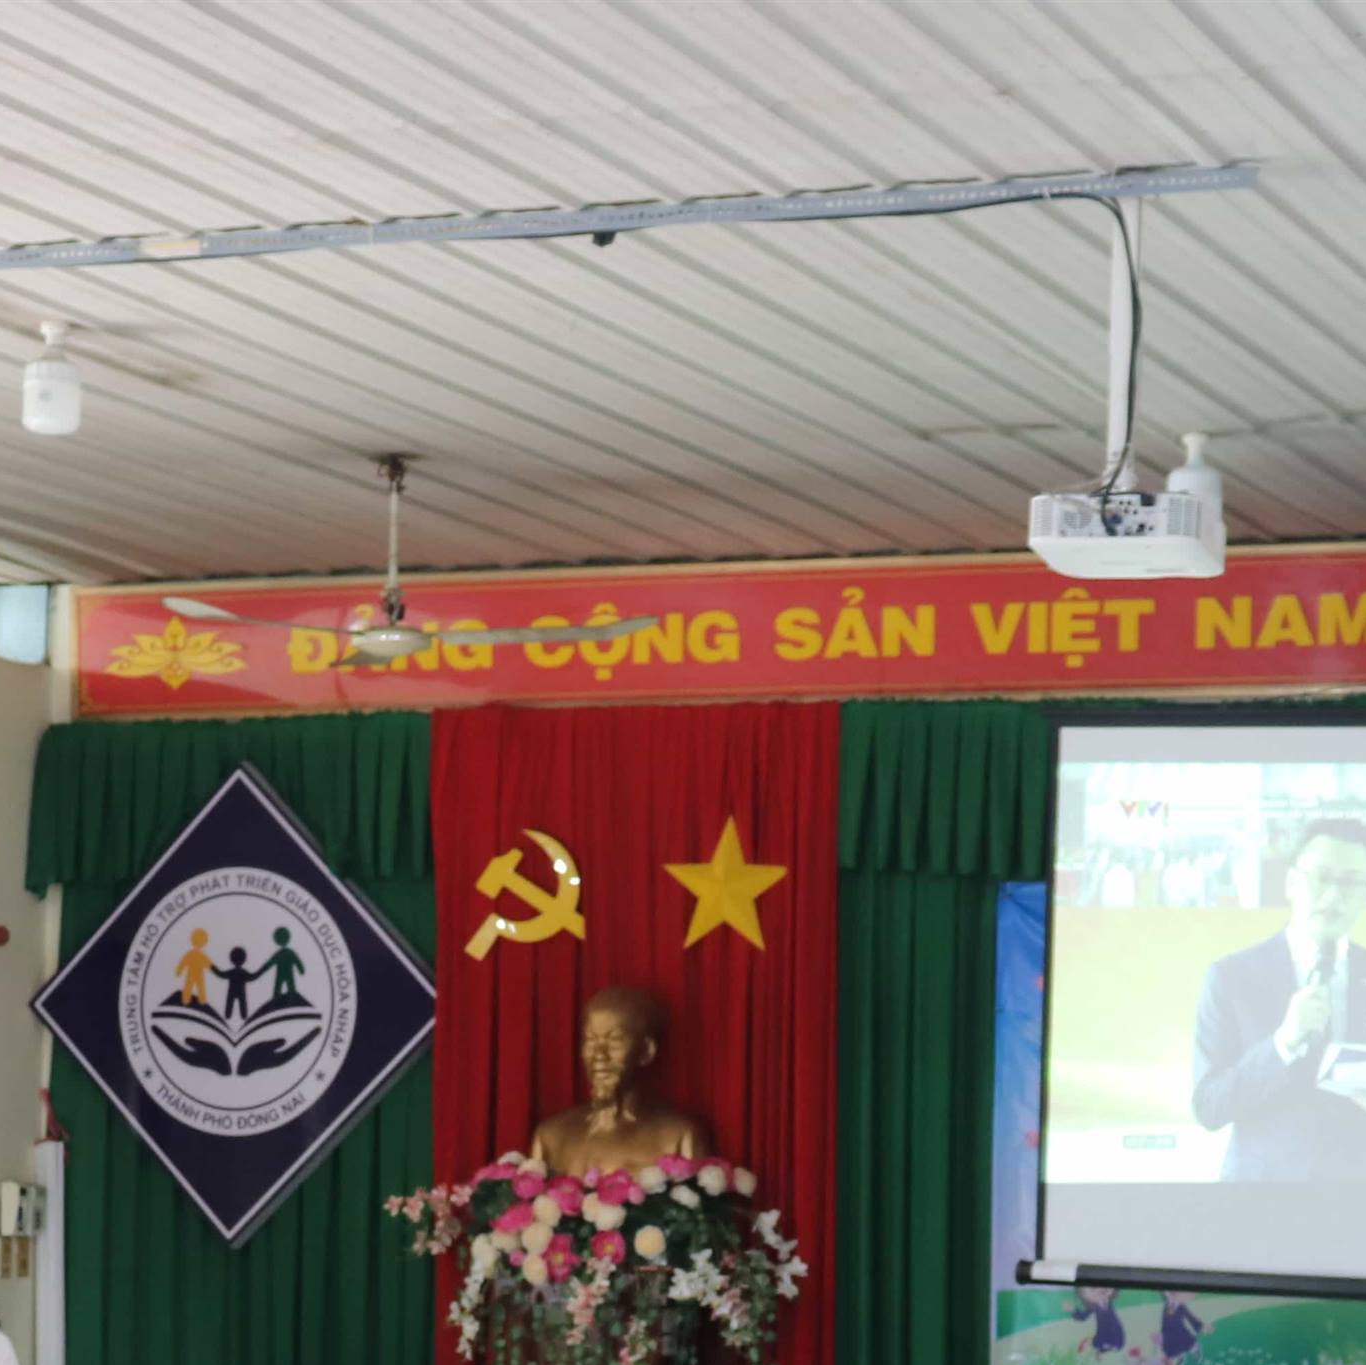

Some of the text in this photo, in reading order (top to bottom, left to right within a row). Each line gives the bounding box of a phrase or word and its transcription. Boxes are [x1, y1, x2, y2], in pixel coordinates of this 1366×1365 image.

[524, 601, 740, 682] CỘNG
[773, 586, 935, 660] SẢN
[970, 587, 1155, 668] VIỆT
[125, 994, 141, 1056] TRUNG
[281, 1090, 306, 1114] NAI
